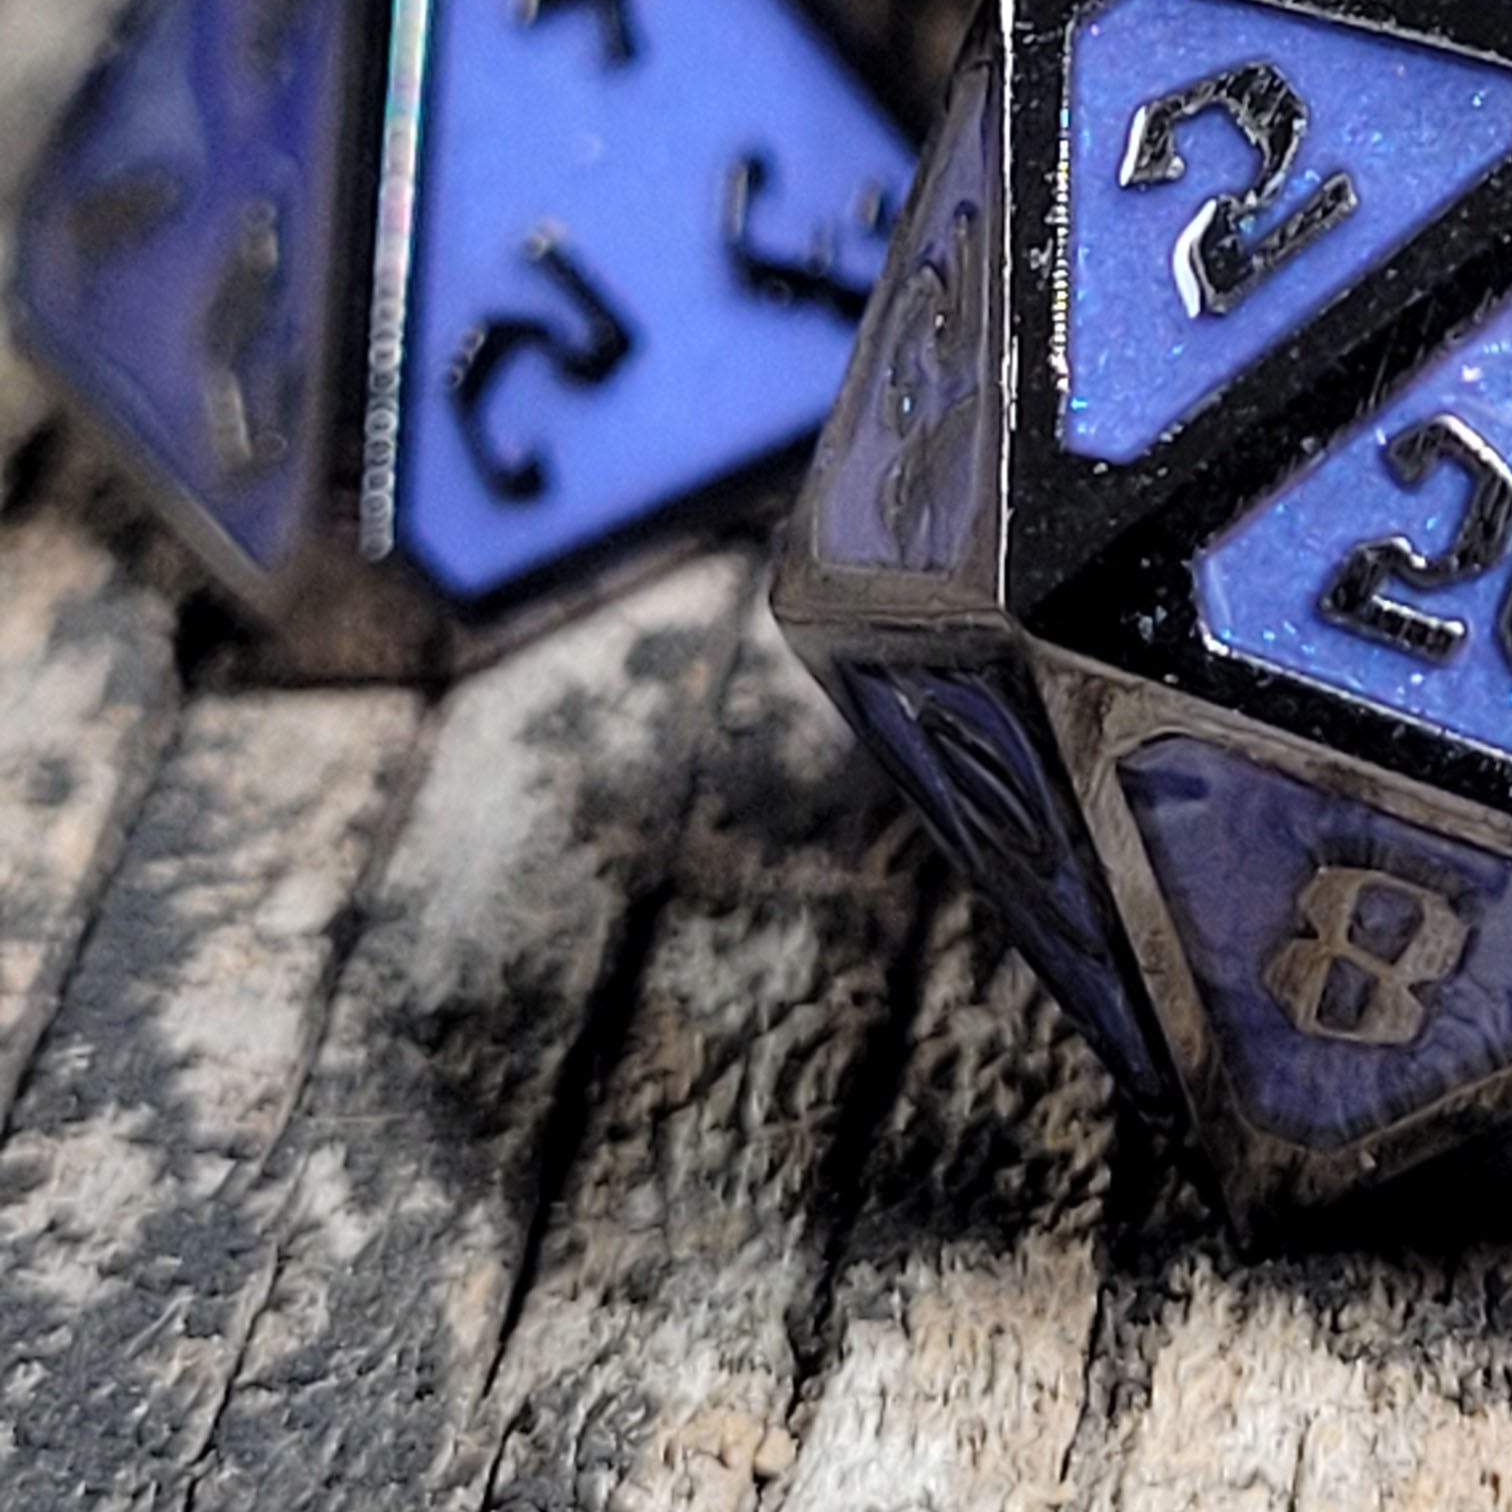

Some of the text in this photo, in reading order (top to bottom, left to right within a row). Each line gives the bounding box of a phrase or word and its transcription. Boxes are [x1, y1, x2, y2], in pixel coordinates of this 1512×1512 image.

[1118, 60, 1360, 318] 2
[444, 218, 634, 506] 2
[1260, 866, 1474, 1048] 8
